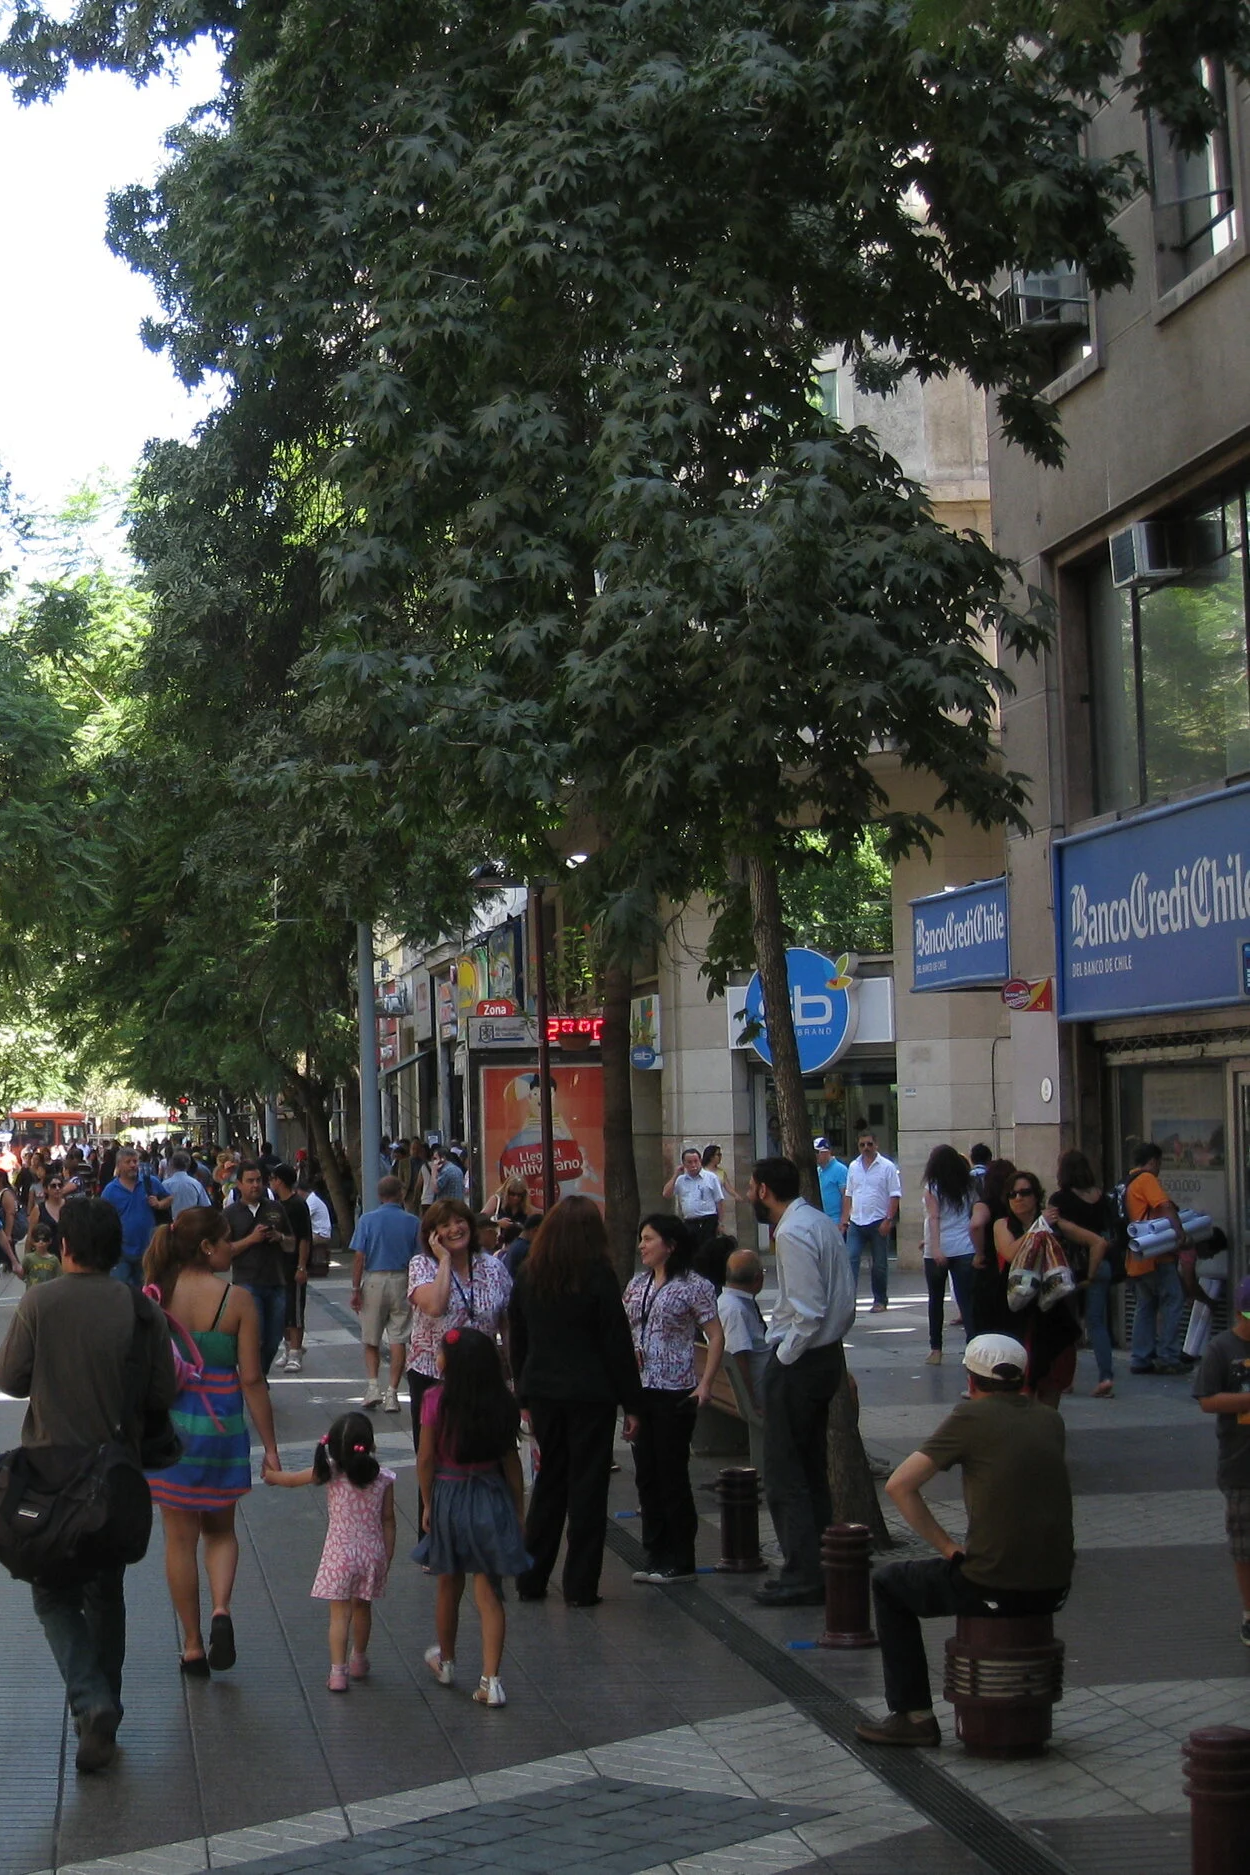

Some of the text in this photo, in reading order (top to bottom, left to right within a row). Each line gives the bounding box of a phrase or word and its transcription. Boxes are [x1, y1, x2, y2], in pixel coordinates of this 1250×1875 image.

[916, 902, 1004, 956] BancoCrediChile
[1072, 954, 1132, 978] DEL BANCO DE CHILE
[483, 1004, 507, 1016] Zona
[760, 1027, 832, 1038] SBRAND
[519, 1151, 543, 1163] Lleg
[503, 1159, 580, 1178] Multivano
